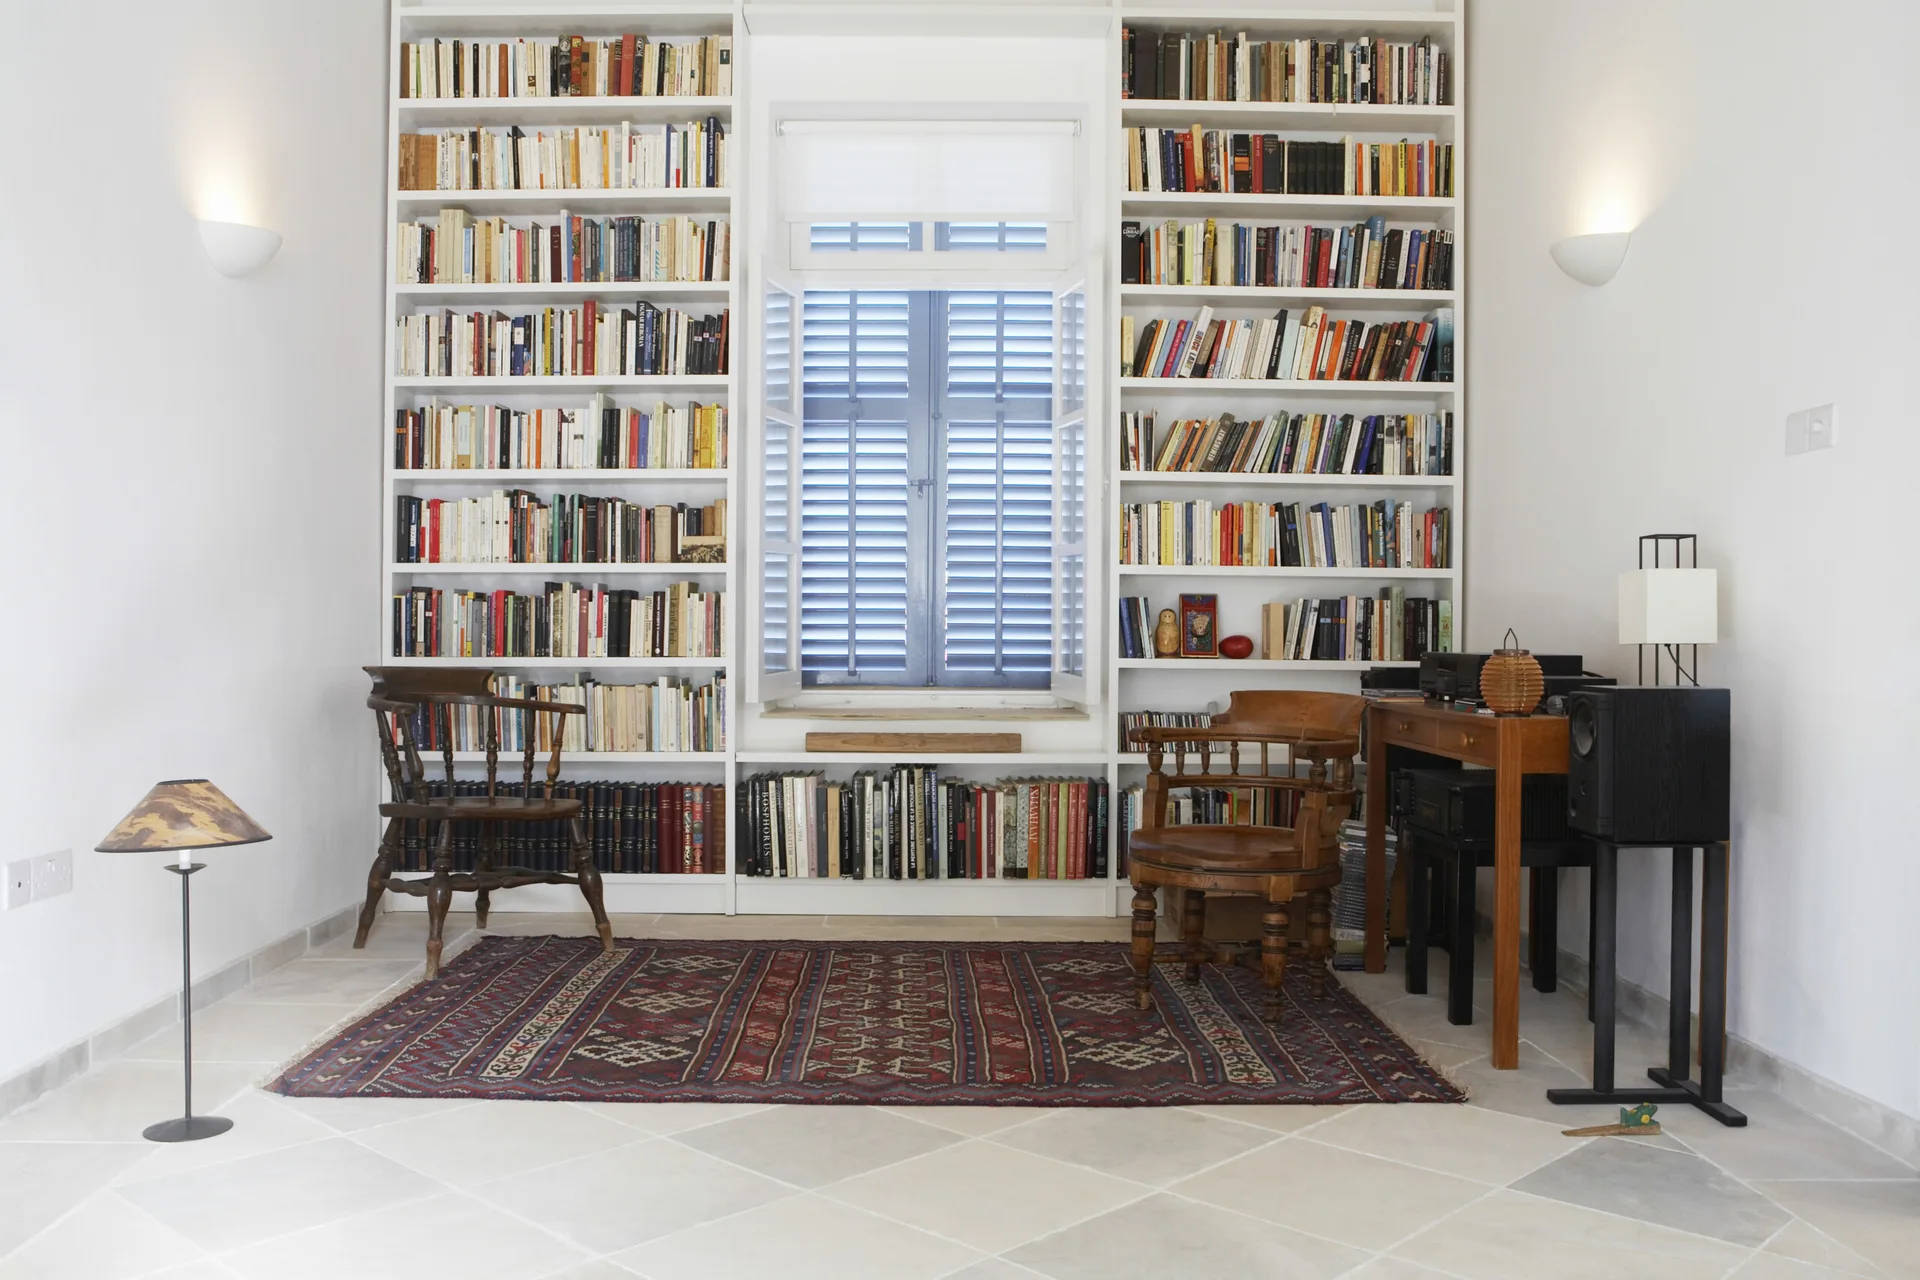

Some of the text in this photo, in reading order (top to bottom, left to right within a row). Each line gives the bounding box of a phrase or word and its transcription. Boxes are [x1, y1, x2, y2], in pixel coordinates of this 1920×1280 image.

[1185, 330, 1204, 370] BRICK LANE
[1206, 429, 1226, 461] HEMINGWAY
[762, 792, 770, 857] BOSPHORUS
